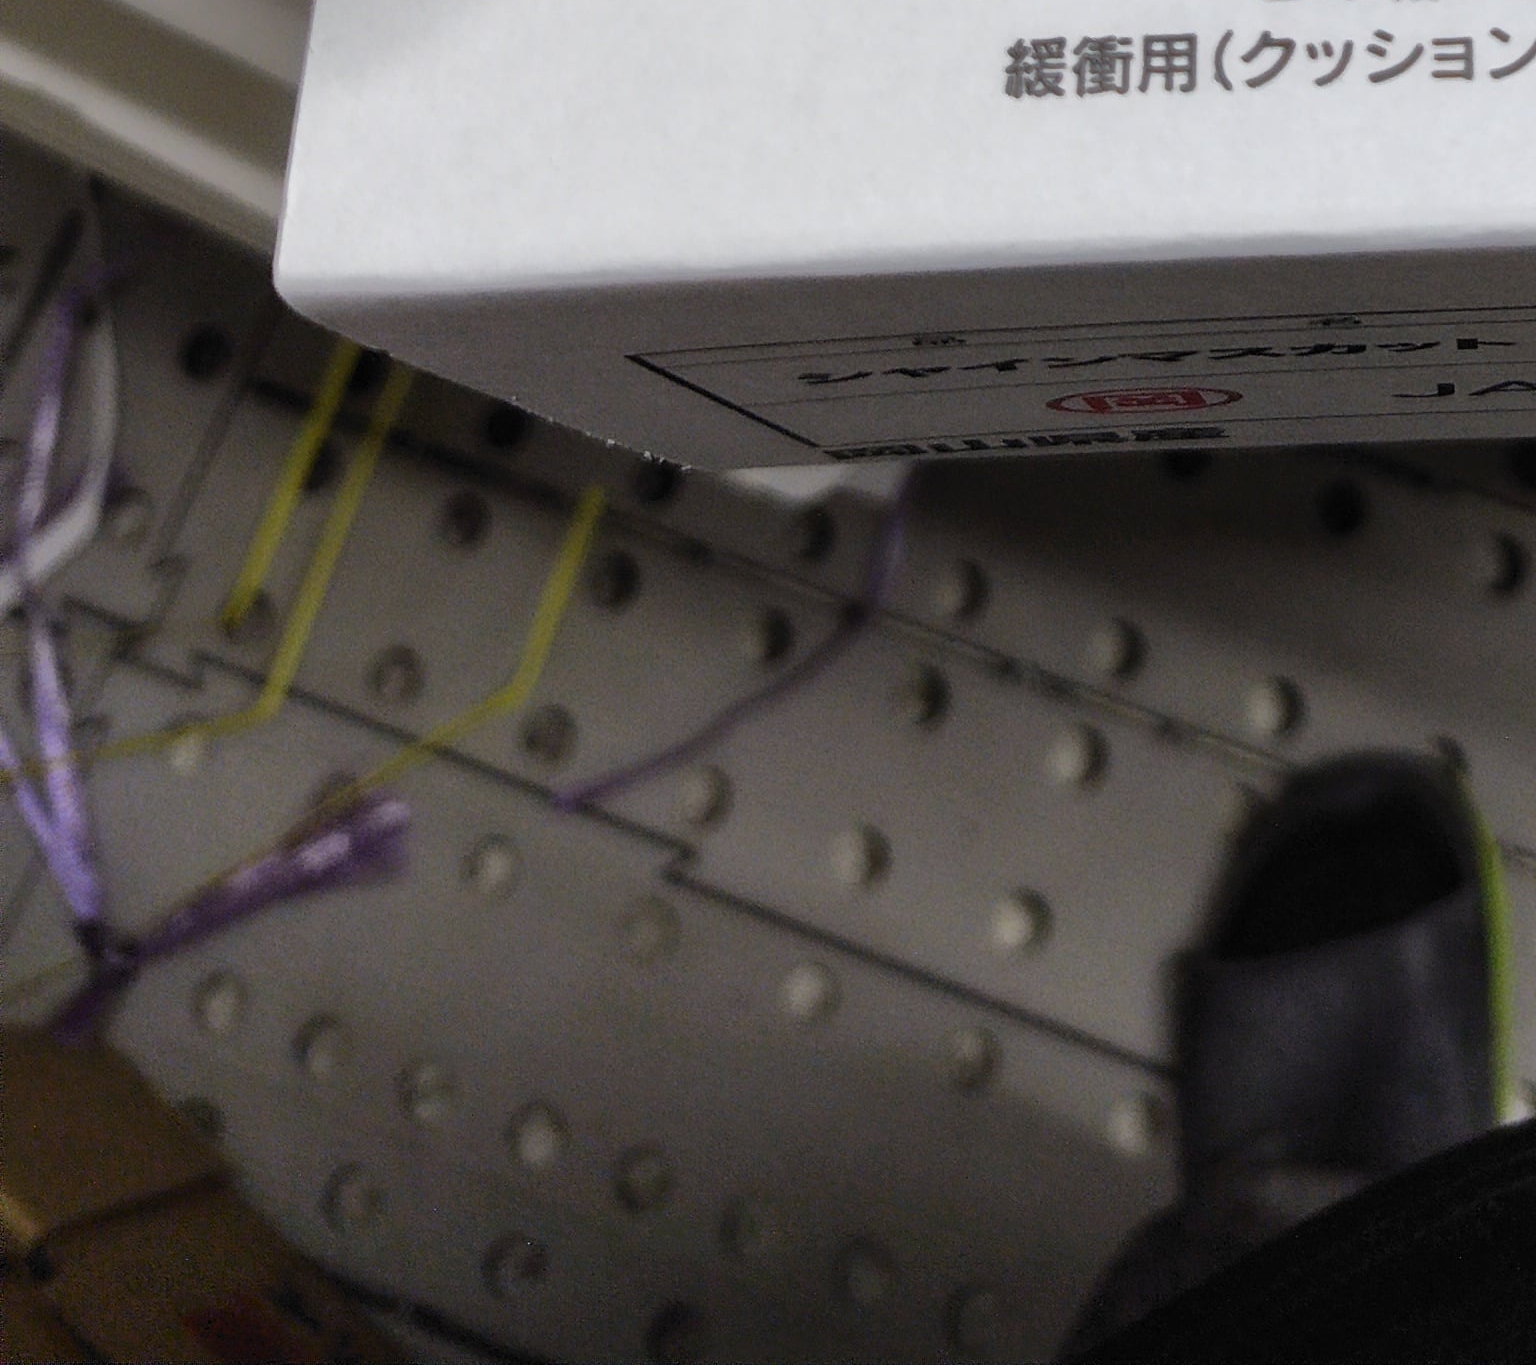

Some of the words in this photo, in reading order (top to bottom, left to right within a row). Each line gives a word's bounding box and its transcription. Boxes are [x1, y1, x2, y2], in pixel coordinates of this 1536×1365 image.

[797, 335, 1518, 386] シャインマスカット
